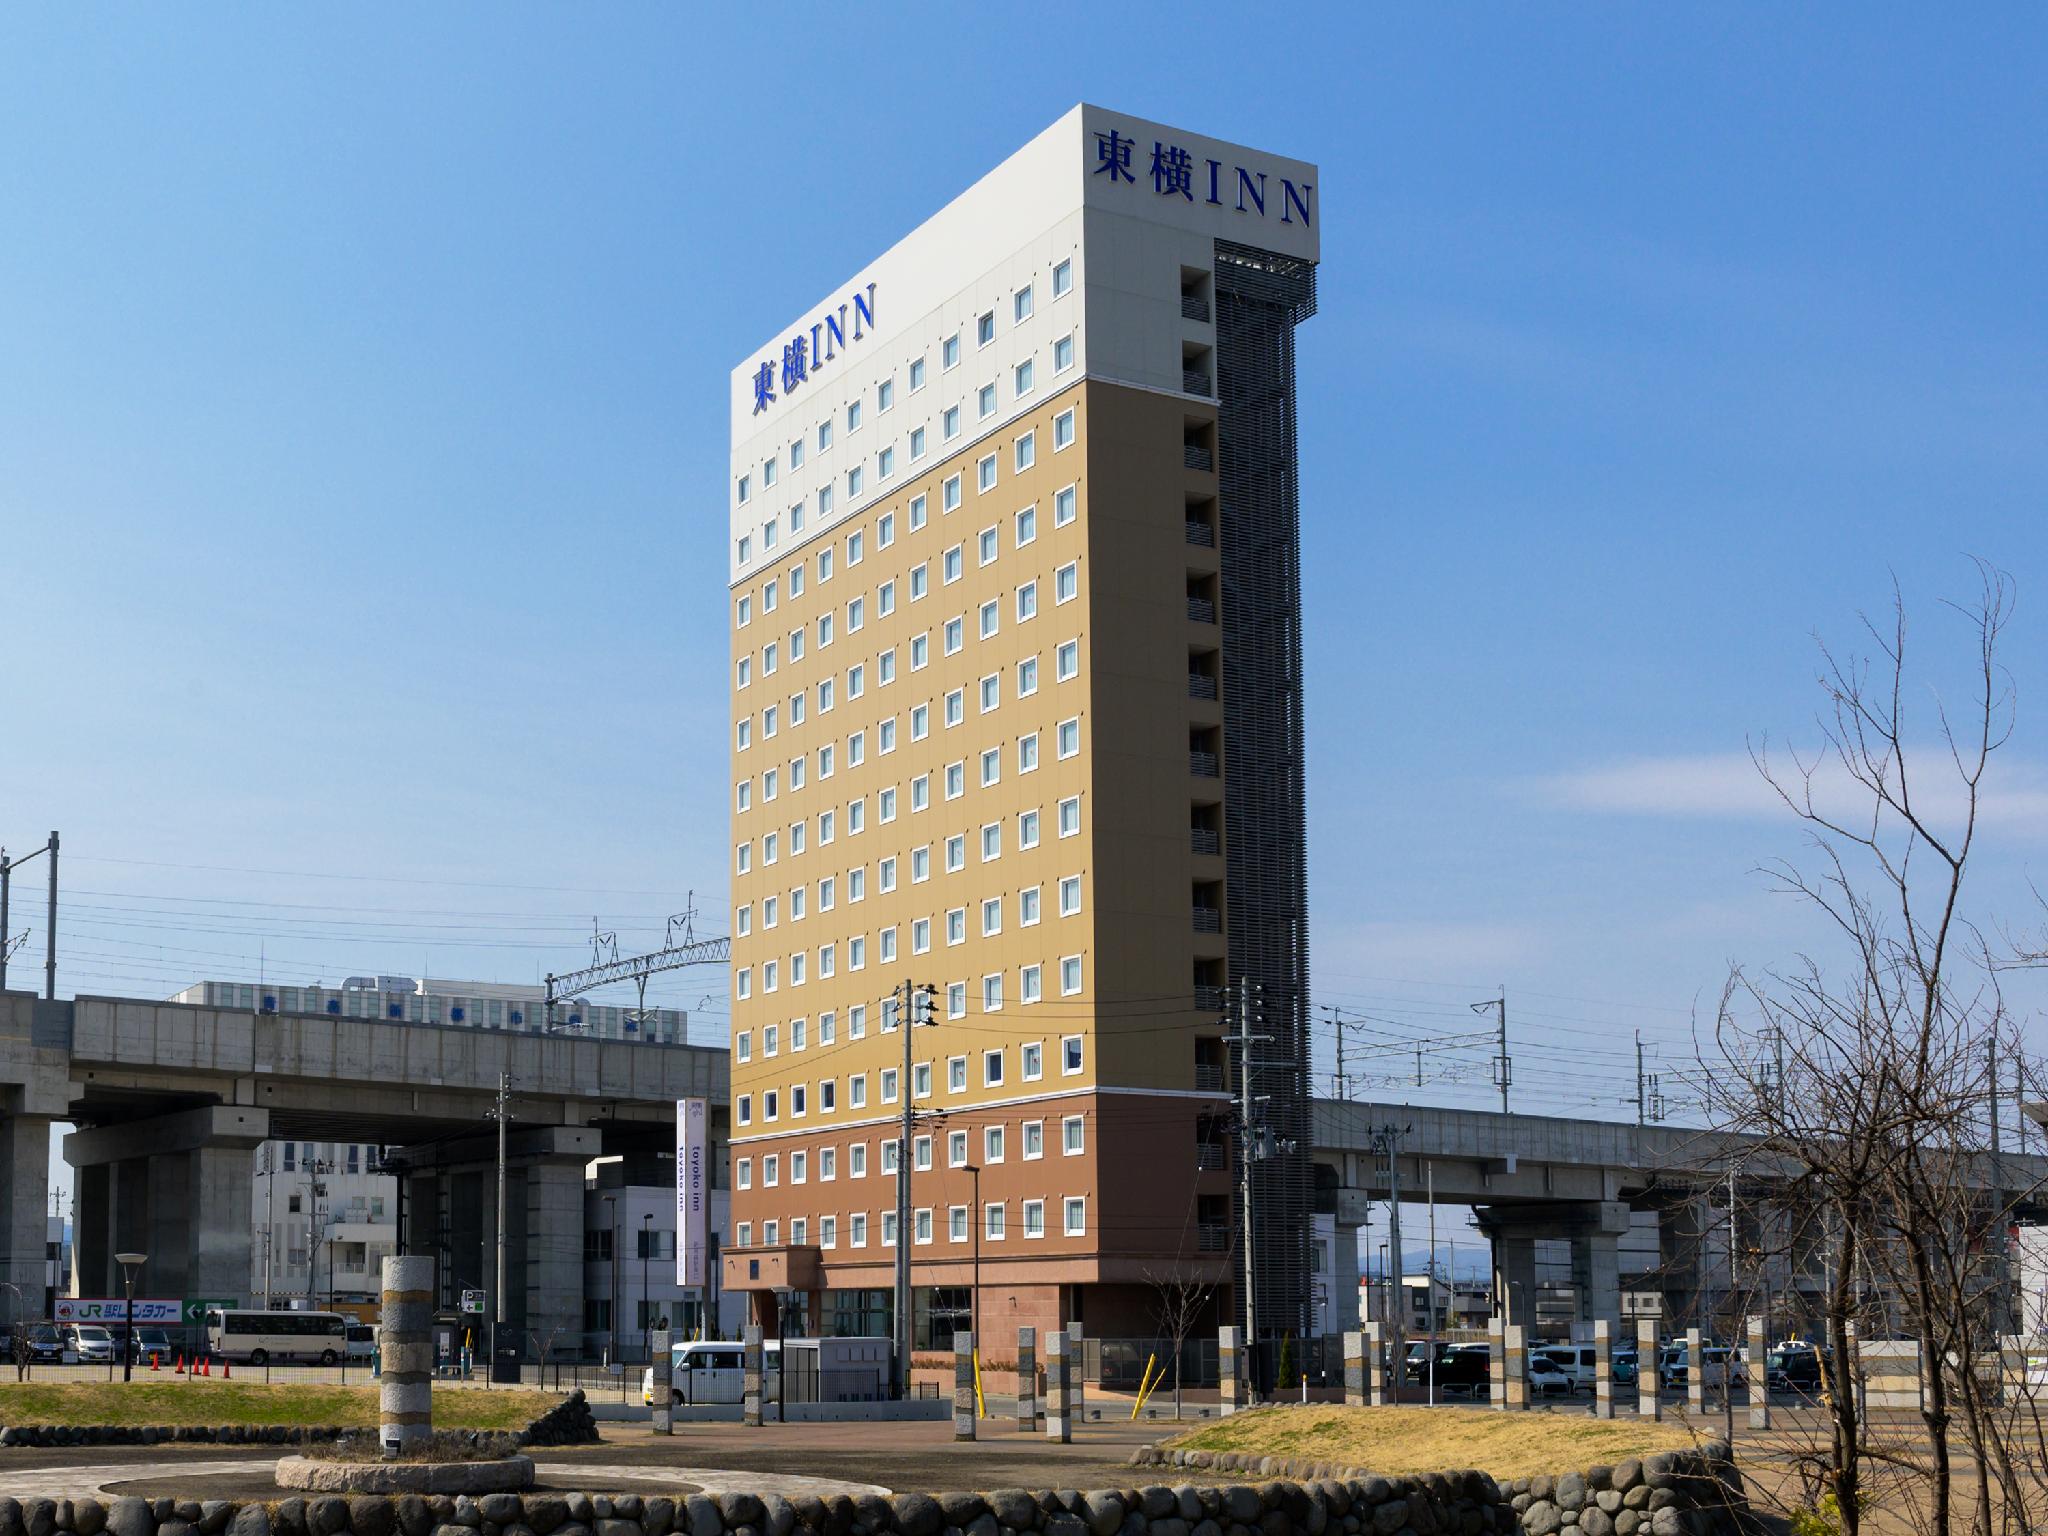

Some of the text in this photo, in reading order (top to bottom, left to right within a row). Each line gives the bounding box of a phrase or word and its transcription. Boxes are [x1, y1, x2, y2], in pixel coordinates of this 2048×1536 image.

[1092, 129, 1313, 229] 東横INN
[752, 282, 877, 416] 東横INN
[691, 1146, 701, 1212] toyoko inn
